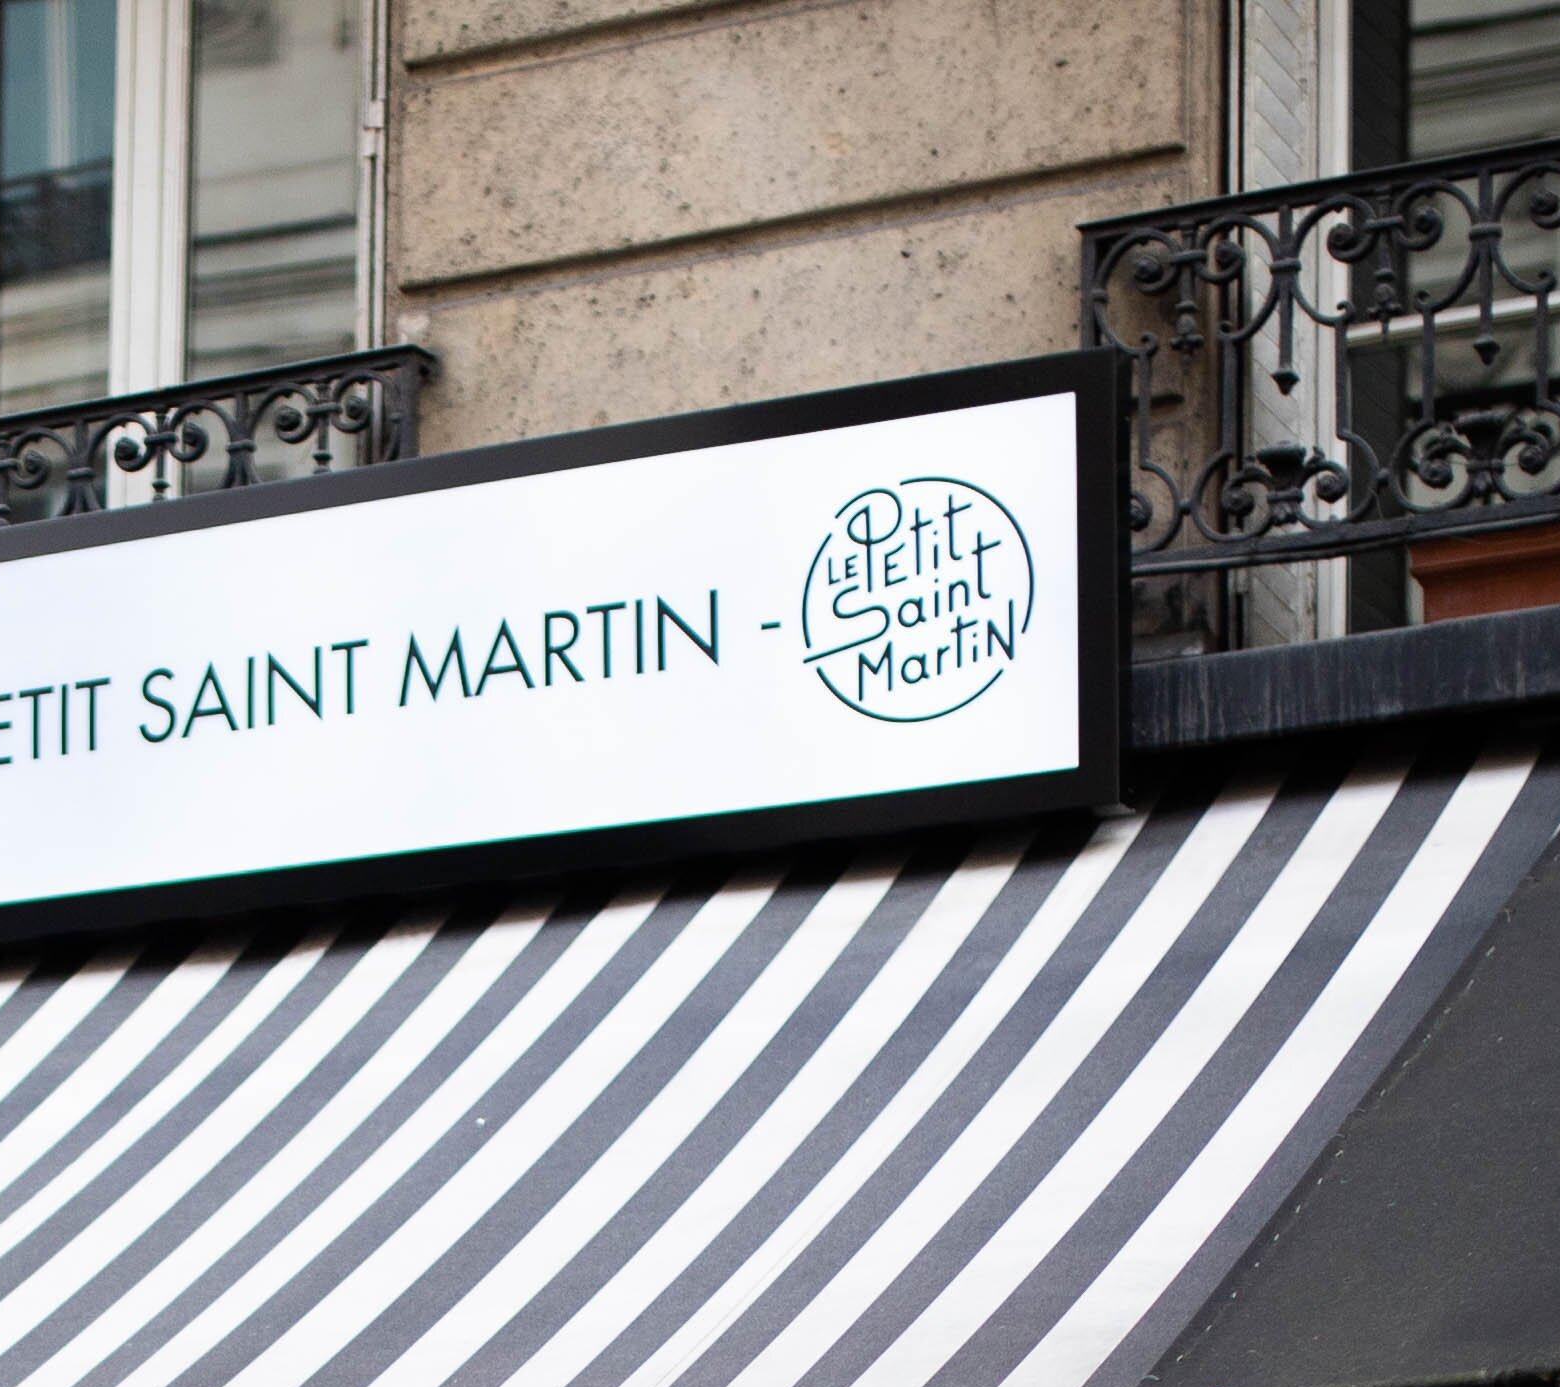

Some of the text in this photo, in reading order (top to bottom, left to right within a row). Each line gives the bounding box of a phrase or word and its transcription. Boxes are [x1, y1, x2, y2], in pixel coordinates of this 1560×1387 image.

[138, 638, 370, 745] SAINT
[398, 588, 720, 708] MARTIN
[803, 530, 1002, 664] Saint
